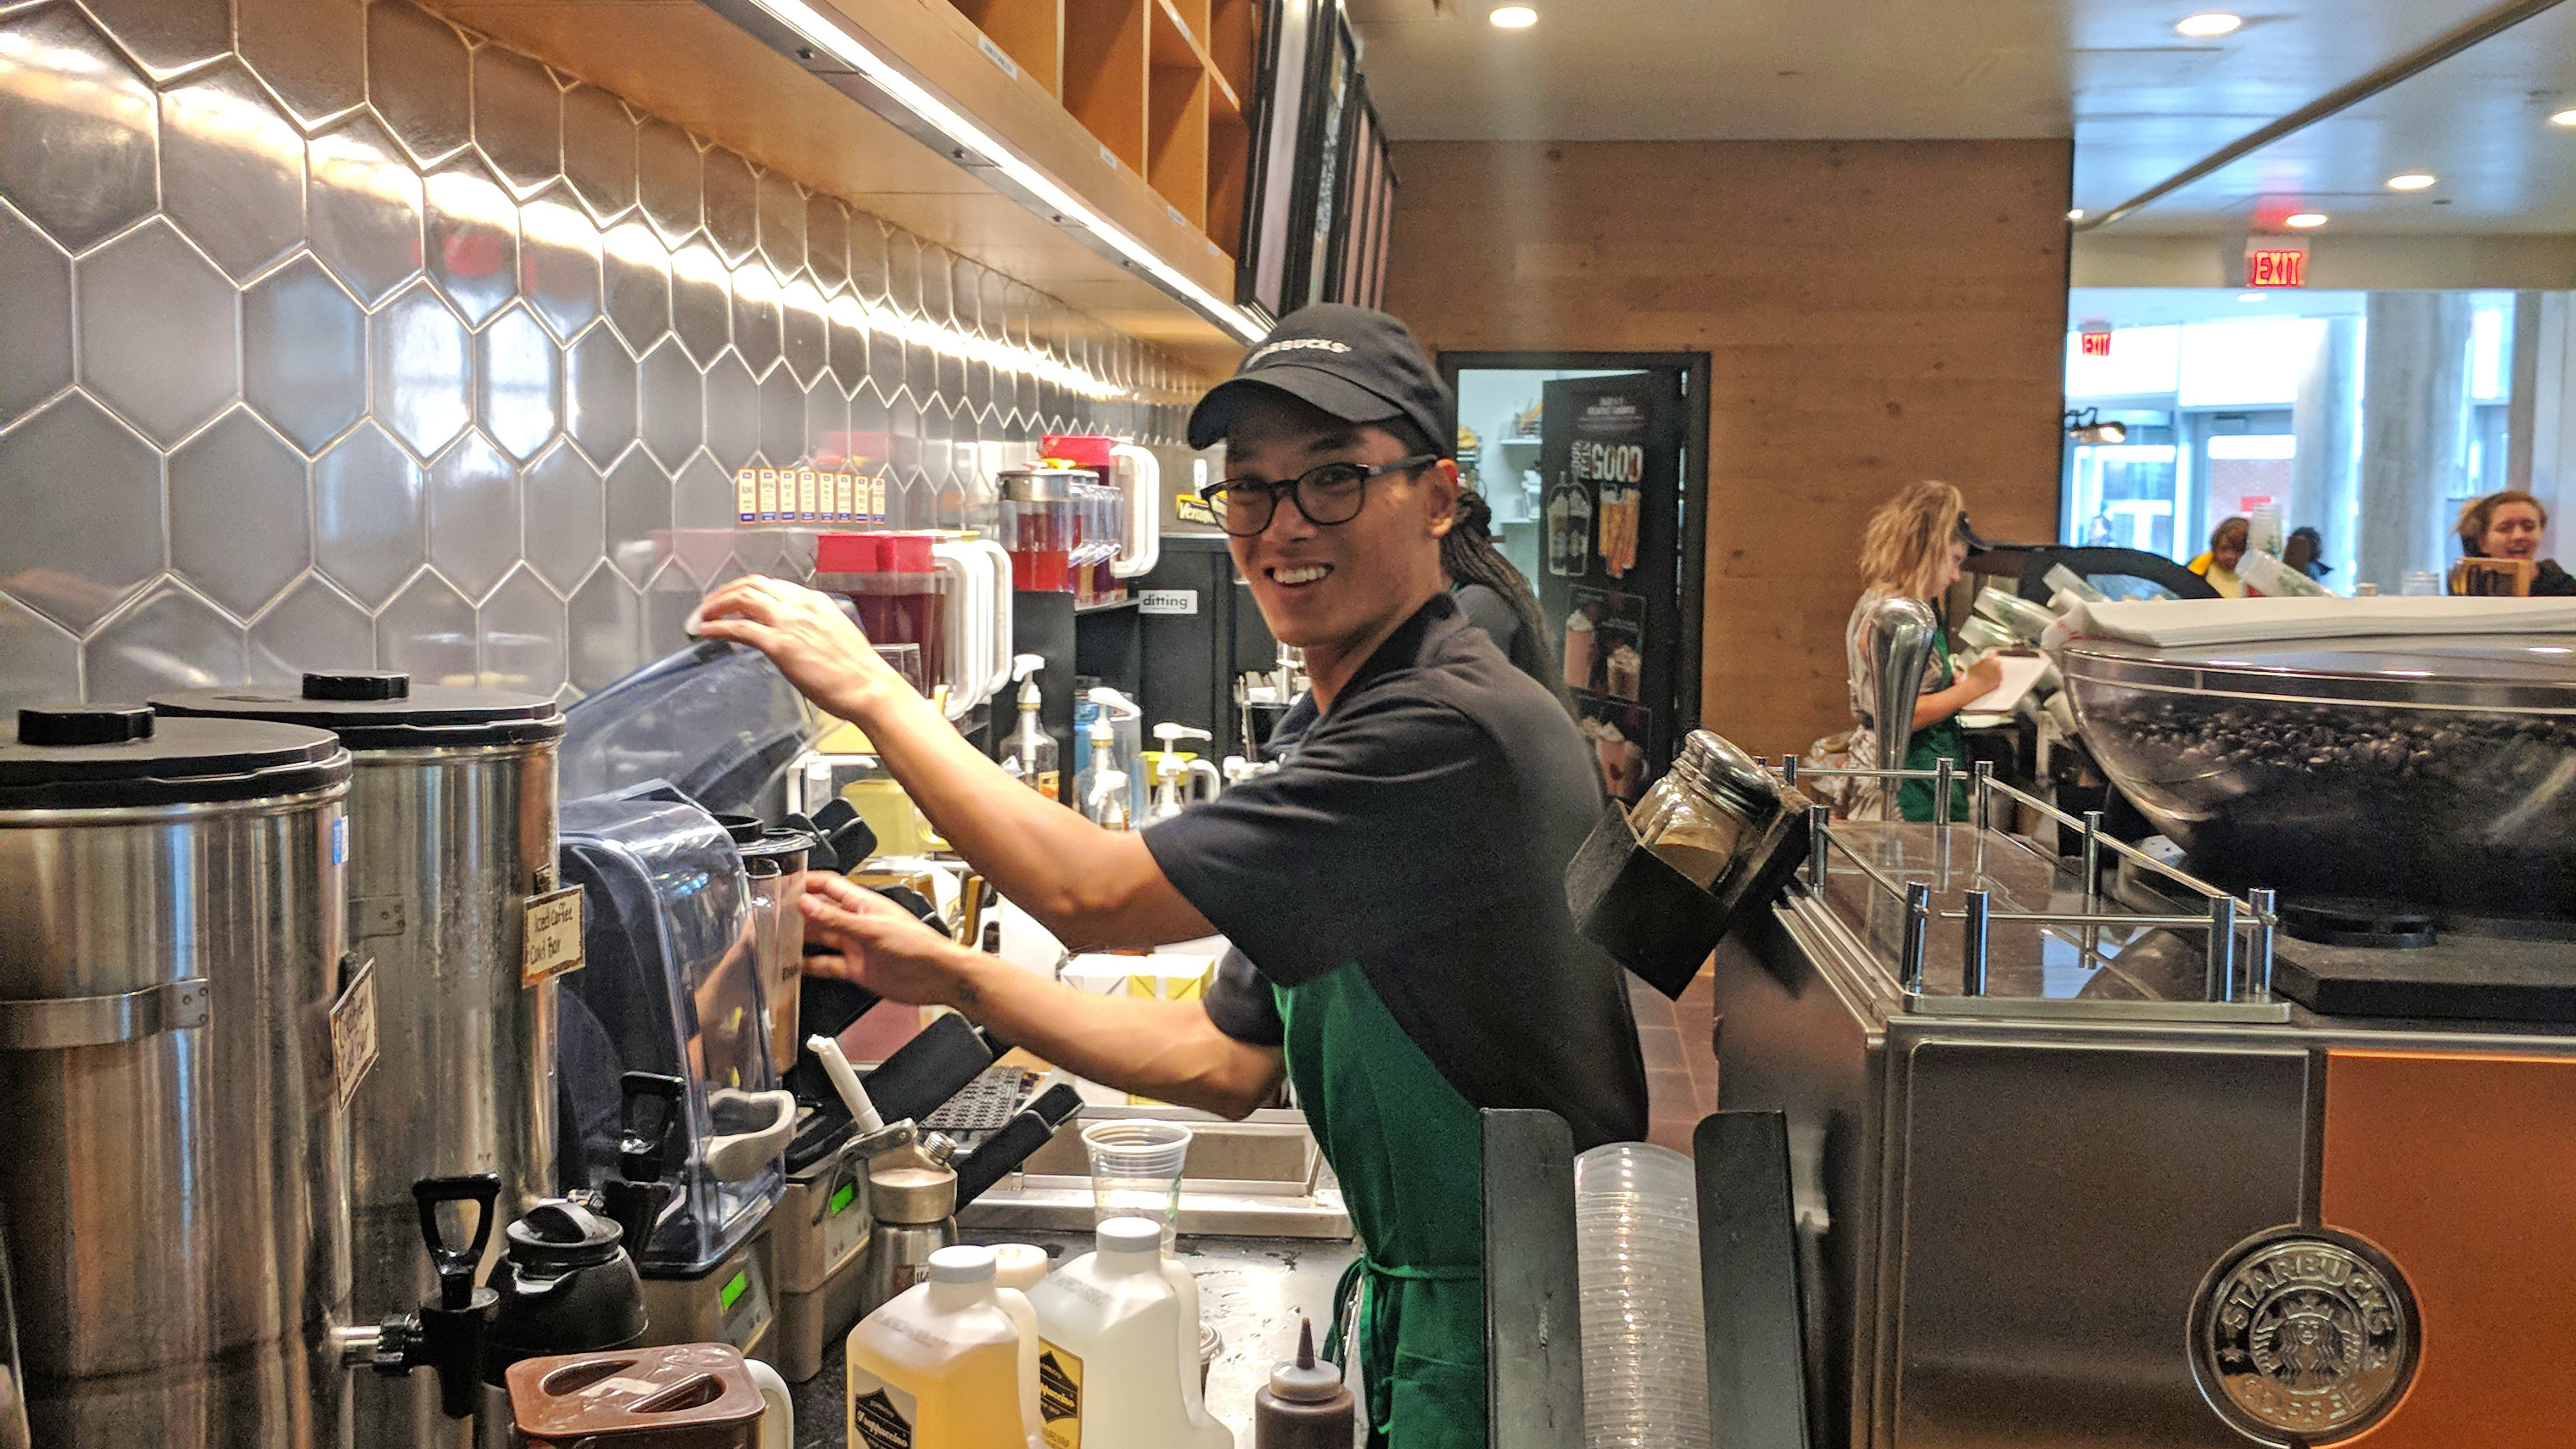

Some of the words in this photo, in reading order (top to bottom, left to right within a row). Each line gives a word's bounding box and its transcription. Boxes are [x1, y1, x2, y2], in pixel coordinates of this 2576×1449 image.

[2255, 252, 2302, 285] EXIT
[2084, 333, 2109, 356] EXIT
[1592, 444, 1644, 483] GOOD
[1143, 595, 1188, 609] ditting
[2220, 1253, 2394, 1335] STARBUCKS
[1039, 1383, 1076, 1408] ppuccino
